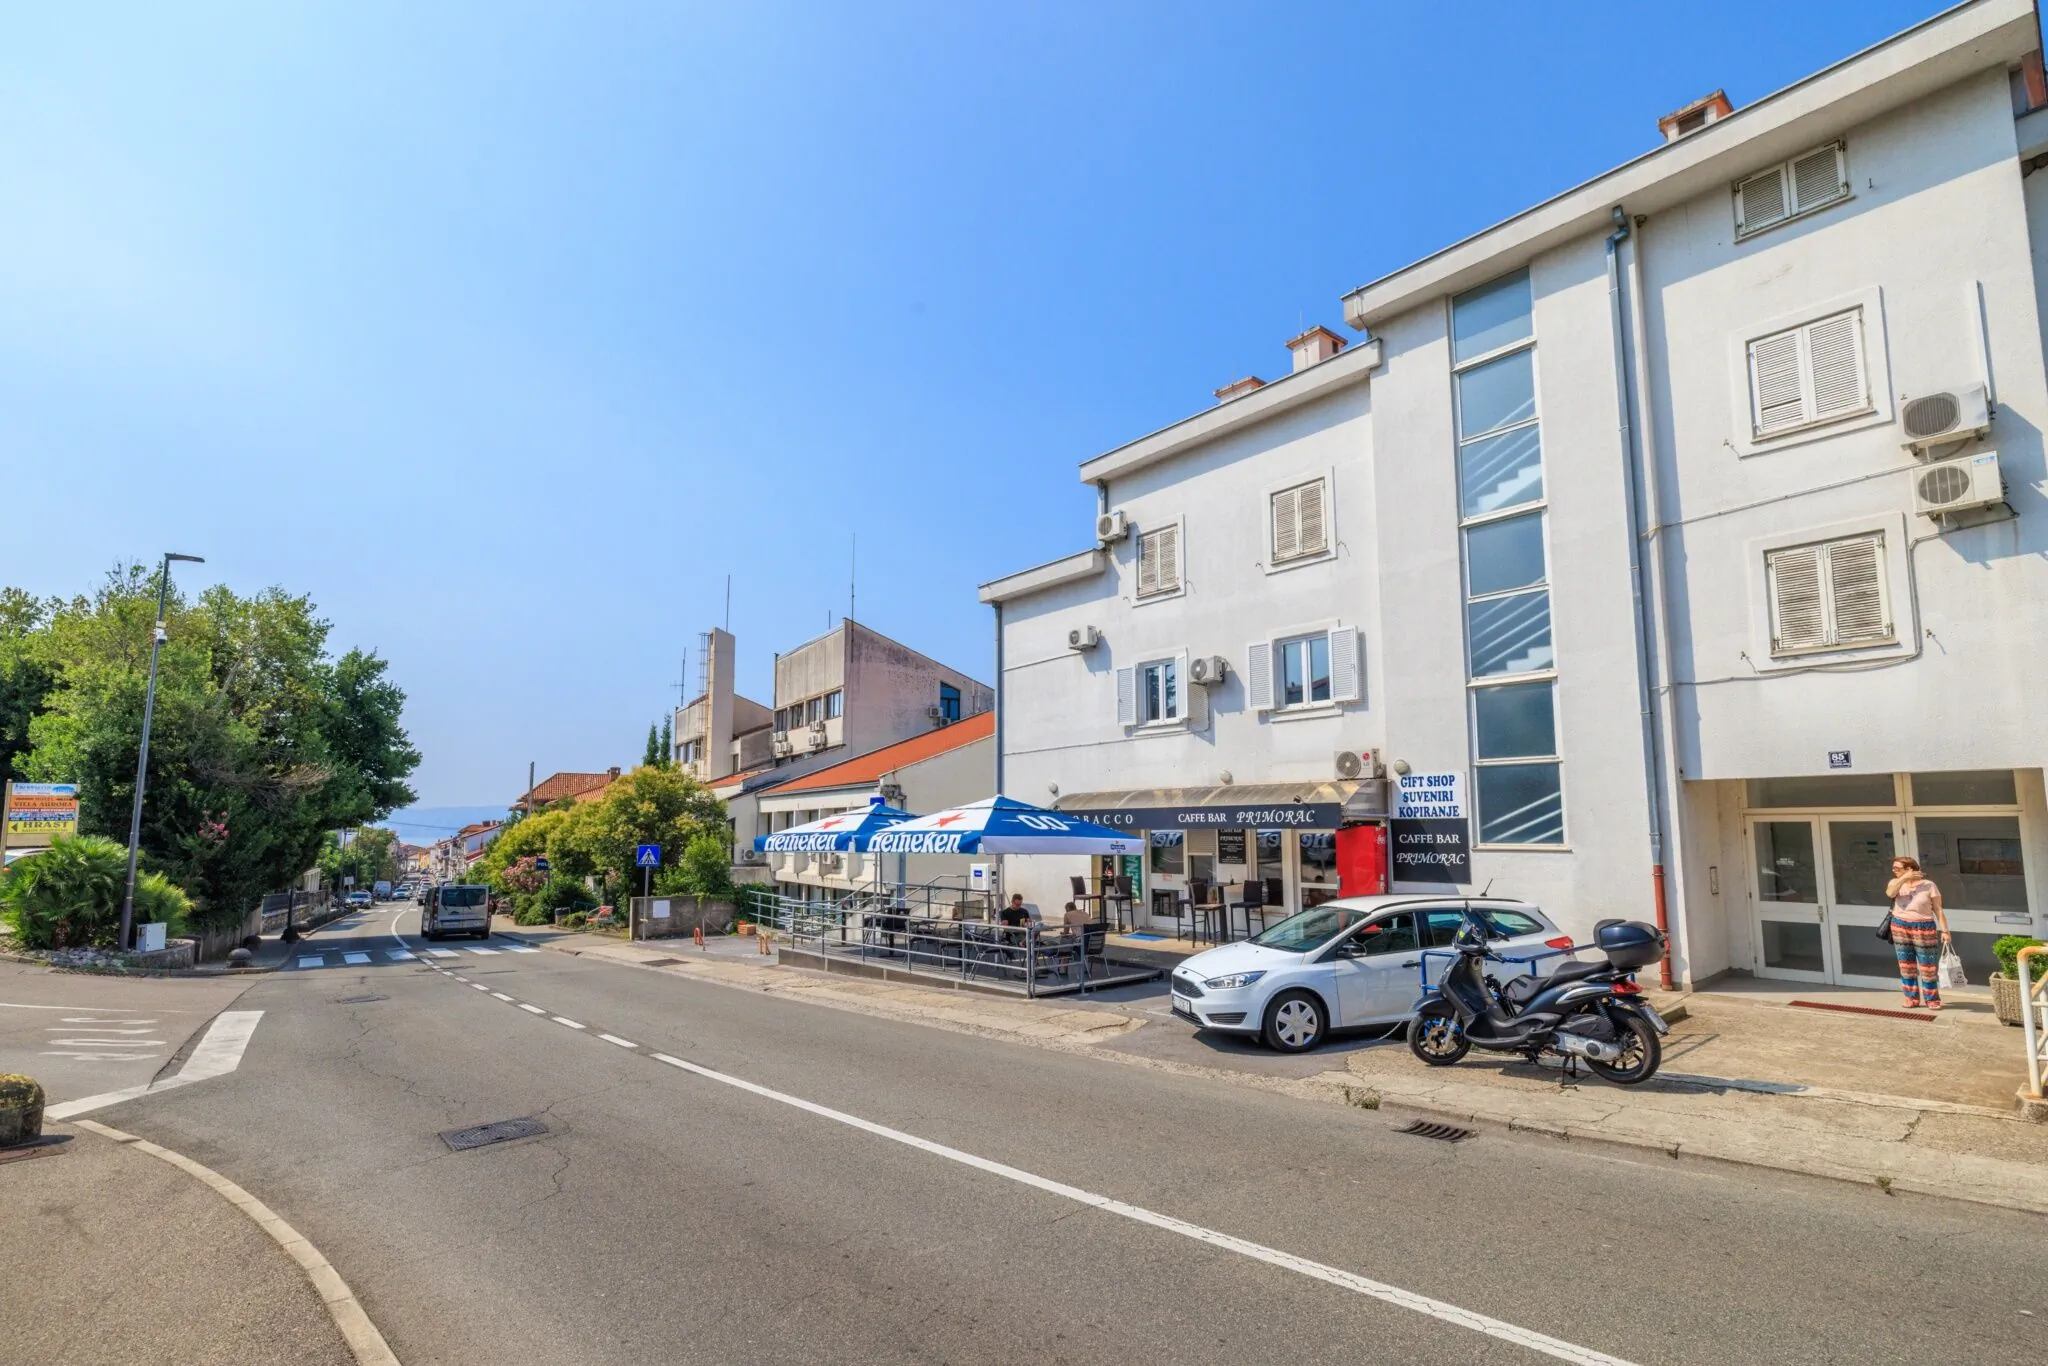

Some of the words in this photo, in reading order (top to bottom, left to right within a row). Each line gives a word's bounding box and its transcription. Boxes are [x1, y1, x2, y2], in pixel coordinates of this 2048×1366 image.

[1401, 776, 1424, 788] GIFT
[1427, 775, 1455, 787] SHOP
[1402, 790, 1454, 803] SUVENIRI
[1178, 813, 1206, 823] CAFFE
[1208, 812, 1227, 823] BAR
[1236, 809, 1315, 825] PRIMORAC
[1398, 805, 1460, 818] KOPIRANJE
[764, 832, 839, 851] Heineken
[866, 831, 962, 853] Heineken
[1399, 834, 1434, 844] CAFFE
[1436, 834, 1461, 844] BAR
[1396, 852, 1465, 866] PRIMORAC
